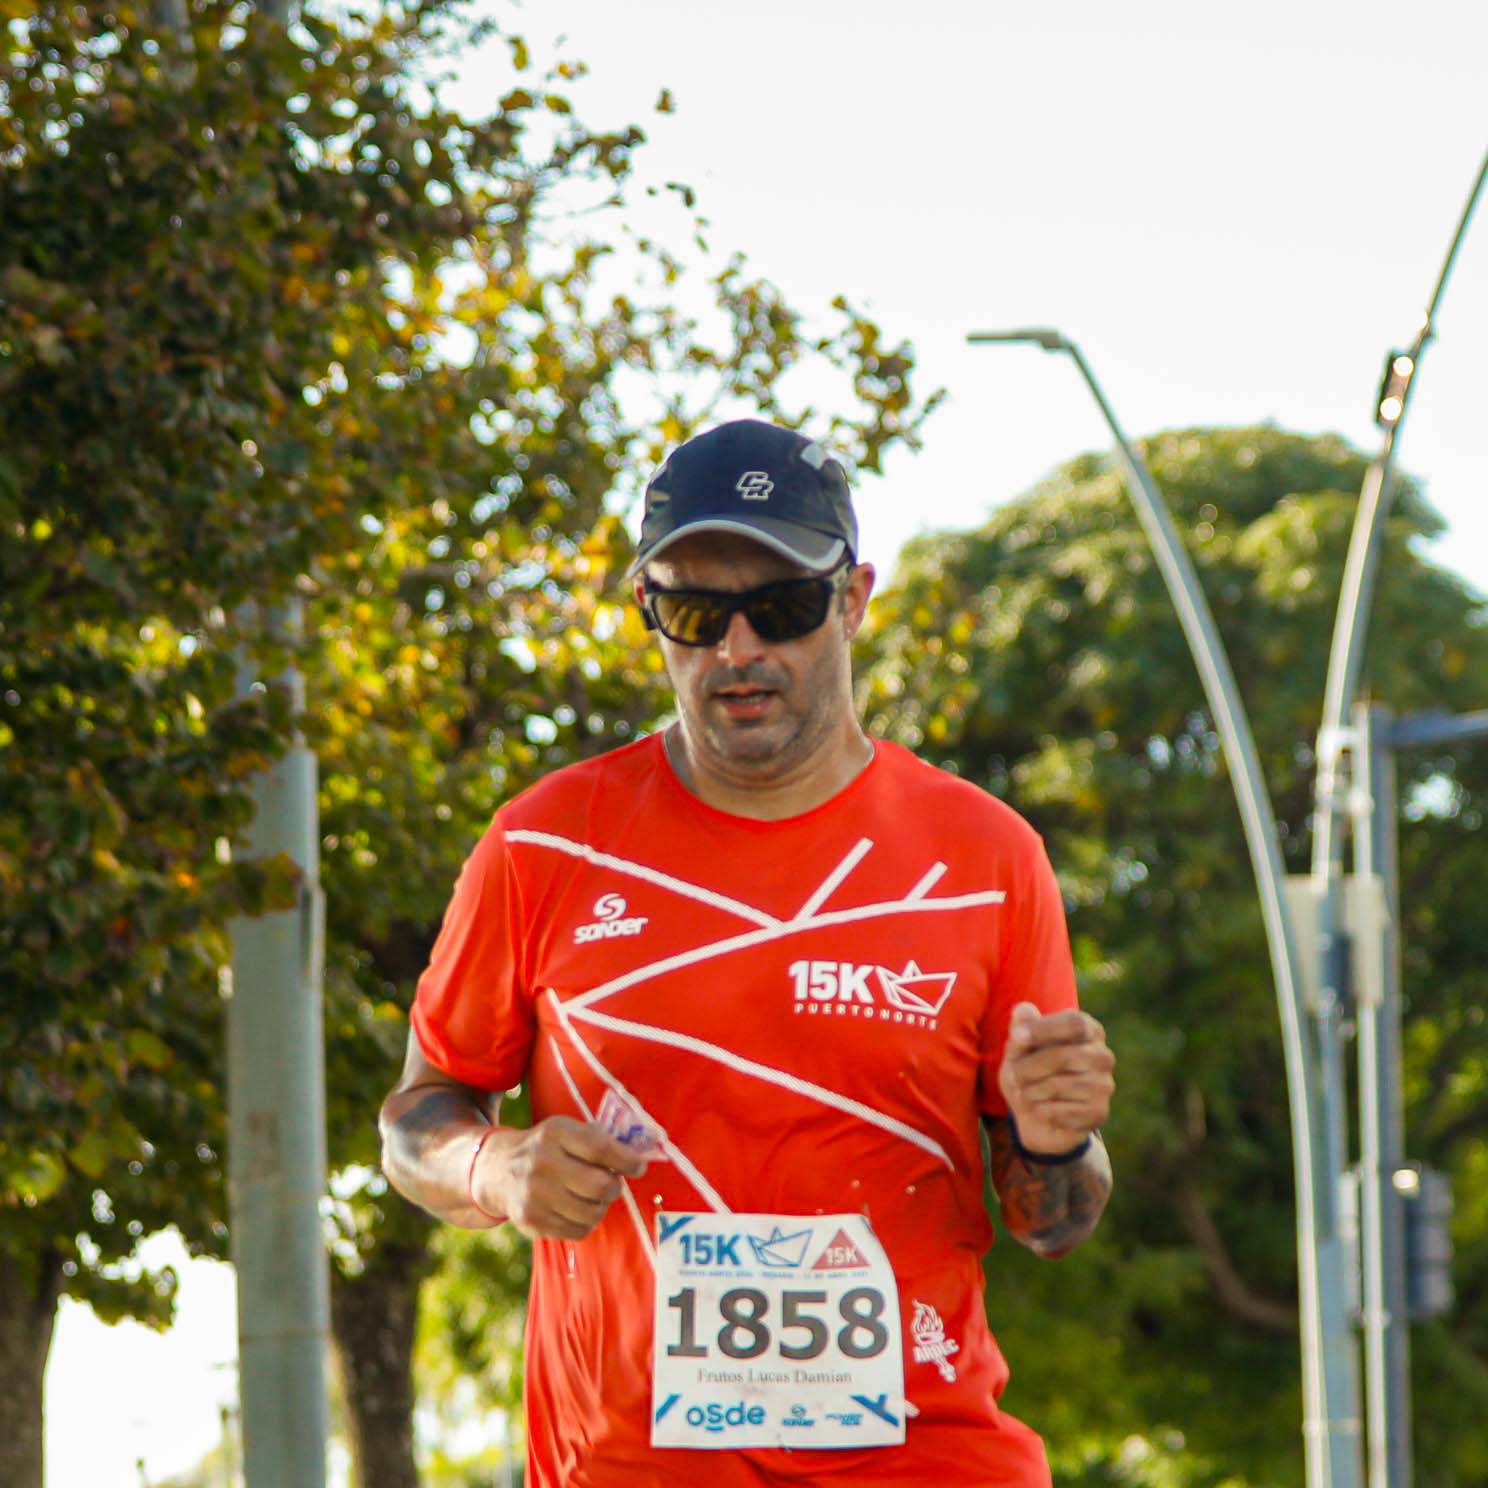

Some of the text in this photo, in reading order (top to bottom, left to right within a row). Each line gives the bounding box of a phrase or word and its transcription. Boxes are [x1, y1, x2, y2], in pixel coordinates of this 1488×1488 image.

[788, 960, 876, 1003] 15K
[794, 1002, 938, 1030] PUERTO NORTE
[679, 1233, 742, 1266] 15K
[826, 1247, 858, 1265] 15K
[666, 1286, 890, 1360] 1858
[685, 1401, 765, 1426] osde
